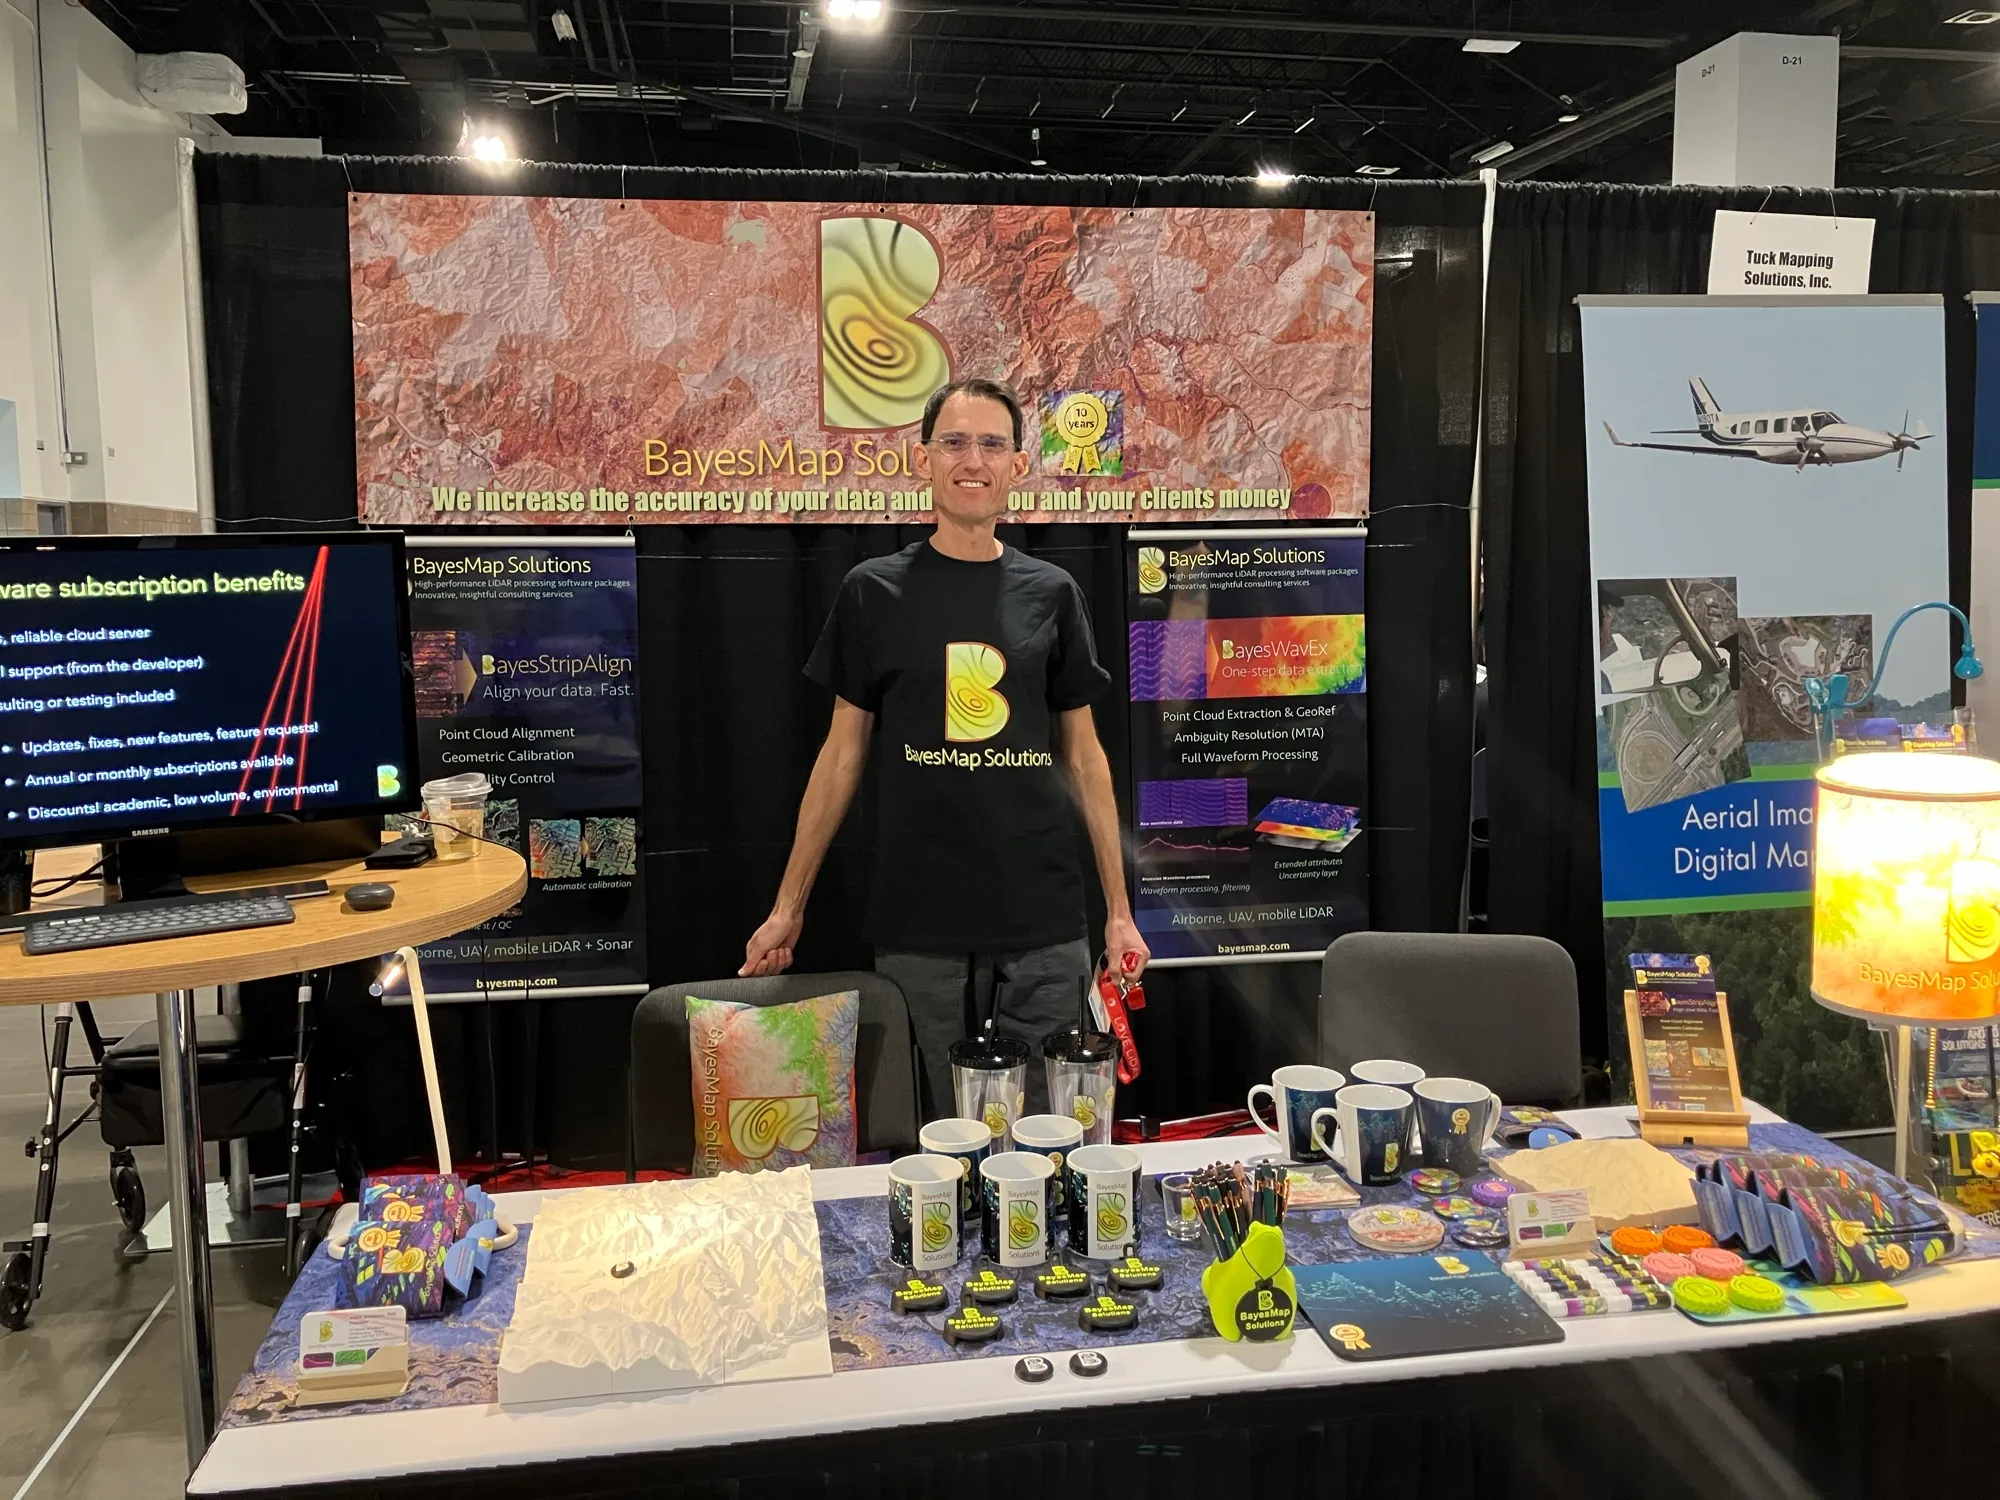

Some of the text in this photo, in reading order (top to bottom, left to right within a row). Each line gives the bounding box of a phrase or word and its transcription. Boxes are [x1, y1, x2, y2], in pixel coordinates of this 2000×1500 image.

[1782, 56, 1803, 65] D-21
[1701, 63, 1715, 78] D-21
[1746, 250, 1834, 271] Tuck Mapping
[1744, 271, 1832, 289] Solutions, Inc.
[1075, 408, 1088, 417] 10
[1068, 420, 1094, 430] years
[645, 439, 844, 485] BayesMap
[432, 486, 1291, 514] We increase the accuracy of your data and ou and your clients money
[1169, 548, 1326, 570] BayesMap Solutions
[413, 556, 592, 578] BayesMap Solutions
[1169, 567, 1359, 581] High-performance LiDAR processing software packages
[59, 574, 208, 601] subscription
[214, 571, 305, 593] benefits
[414, 578, 631, 589] High-performance LiDAR processing software packages
[1169, 579, 1310, 591] Innovative, insightful consulting services
[414, 590, 574, 600] Innovative, insightful consulting services
[11, 627, 153, 644] reliable cloud server
[1222, 639, 1328, 662] BayesWavEx
[8, 656, 205, 680] support (from the developer)
[481, 653, 632, 678] BayesStripAlign
[1222, 665, 1277, 679] One-step
[1278, 663, 1305, 677] data
[47, 698, 62, 708] or
[66, 693, 113, 708] testing
[116, 688, 175, 704] included
[482, 683, 634, 702] Align your data. Fast.
[1163, 706, 1336, 722] Point Cloud Extraction & GeoRef
[22, 720, 319, 756] Updates, fixes, new features, feature requests!
[439, 727, 576, 741] Point Cloud Alignment
[1174, 726, 1324, 745] Ambiguity Resolution (MTA)
[441, 750, 575, 764] Geometric Calibration
[904, 744, 1053, 771] BayesMap Solutions
[1181, 749, 1319, 763] Full Waveform Processing
[25, 753, 295, 787] Annual or monthly subscriptions available
[509, 772, 556, 785] Control
[28, 780, 339, 820] Discounts! academic, low volume, environmental
[1682, 798, 1814, 831] Aerial Ima
[131, 827, 170, 837] SAMSUNG
[1274, 857, 1344, 869] Extended attributes
[1674, 841, 1756, 881] Digital
[1279, 868, 1339, 880] Uncertainty layer
[542, 879, 632, 892] Automatic calibration
[1140, 883, 1251, 896] Waveform processing, filtering
[1172, 906, 1334, 926] Airborne, UAV, mobile LiDAR
[498, 920, 513, 930] QC
[460, 944, 491, 958] UAV,
[494, 941, 539, 956] mobile
[542, 941, 582, 954] LiDAR
[596, 938, 634, 951] Sonar
[1218, 941, 1290, 954] bayesmap.com
[1647, 970, 1703, 978] BayesMap Solutions
[1860, 963, 1966, 992] BayesMap
[1114, 1016, 1130, 1046] LOVE
[1968, 1028, 1986, 1040] AND
[1941, 1039, 1987, 1051] SOLUTIONS
[702, 1027, 724, 1116] BayesMap
[1096, 1182, 1128, 1191] BayesMap
[921, 1190, 952, 1201] BayesMap
[1008, 1189, 1040, 1199] BayesMap
[921, 1250, 953, 1262] Solutions
[1008, 1249, 1040, 1260] Solutions
[1112, 1266, 1160, 1276] BayesMap
[1119, 1271, 1157, 1279] Solutions
[895, 1285, 944, 1297] BayesMap
[966, 1279, 1015, 1290] BayesMap
[972, 1284, 1012, 1293] Solutions
[903, 1290, 942, 1301] Solutions
[1240, 1306, 1291, 1322] BayesMap
[1245, 1317, 1285, 1332] Solutions
